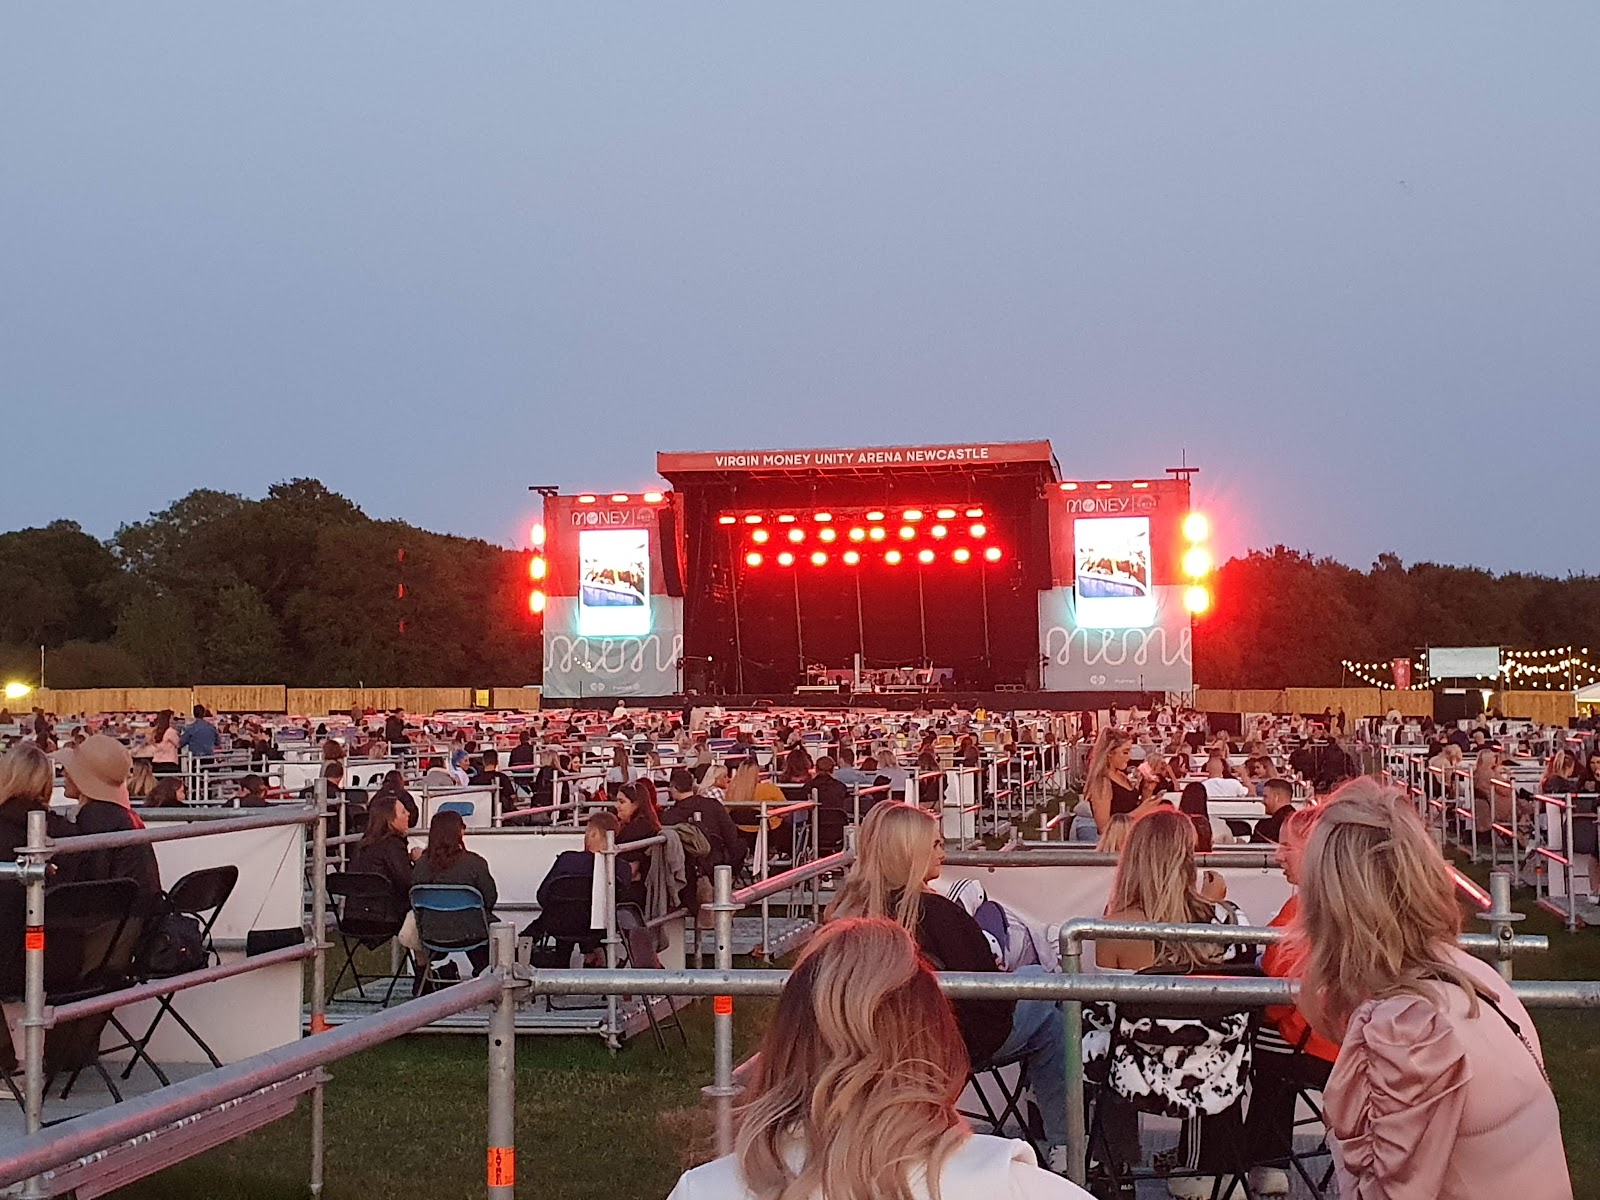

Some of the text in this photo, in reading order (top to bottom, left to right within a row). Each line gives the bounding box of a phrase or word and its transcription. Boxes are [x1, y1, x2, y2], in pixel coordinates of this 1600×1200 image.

[715, 448, 989, 467] VIRGIN MONEY UNITY ARENA NEWCASTLE
